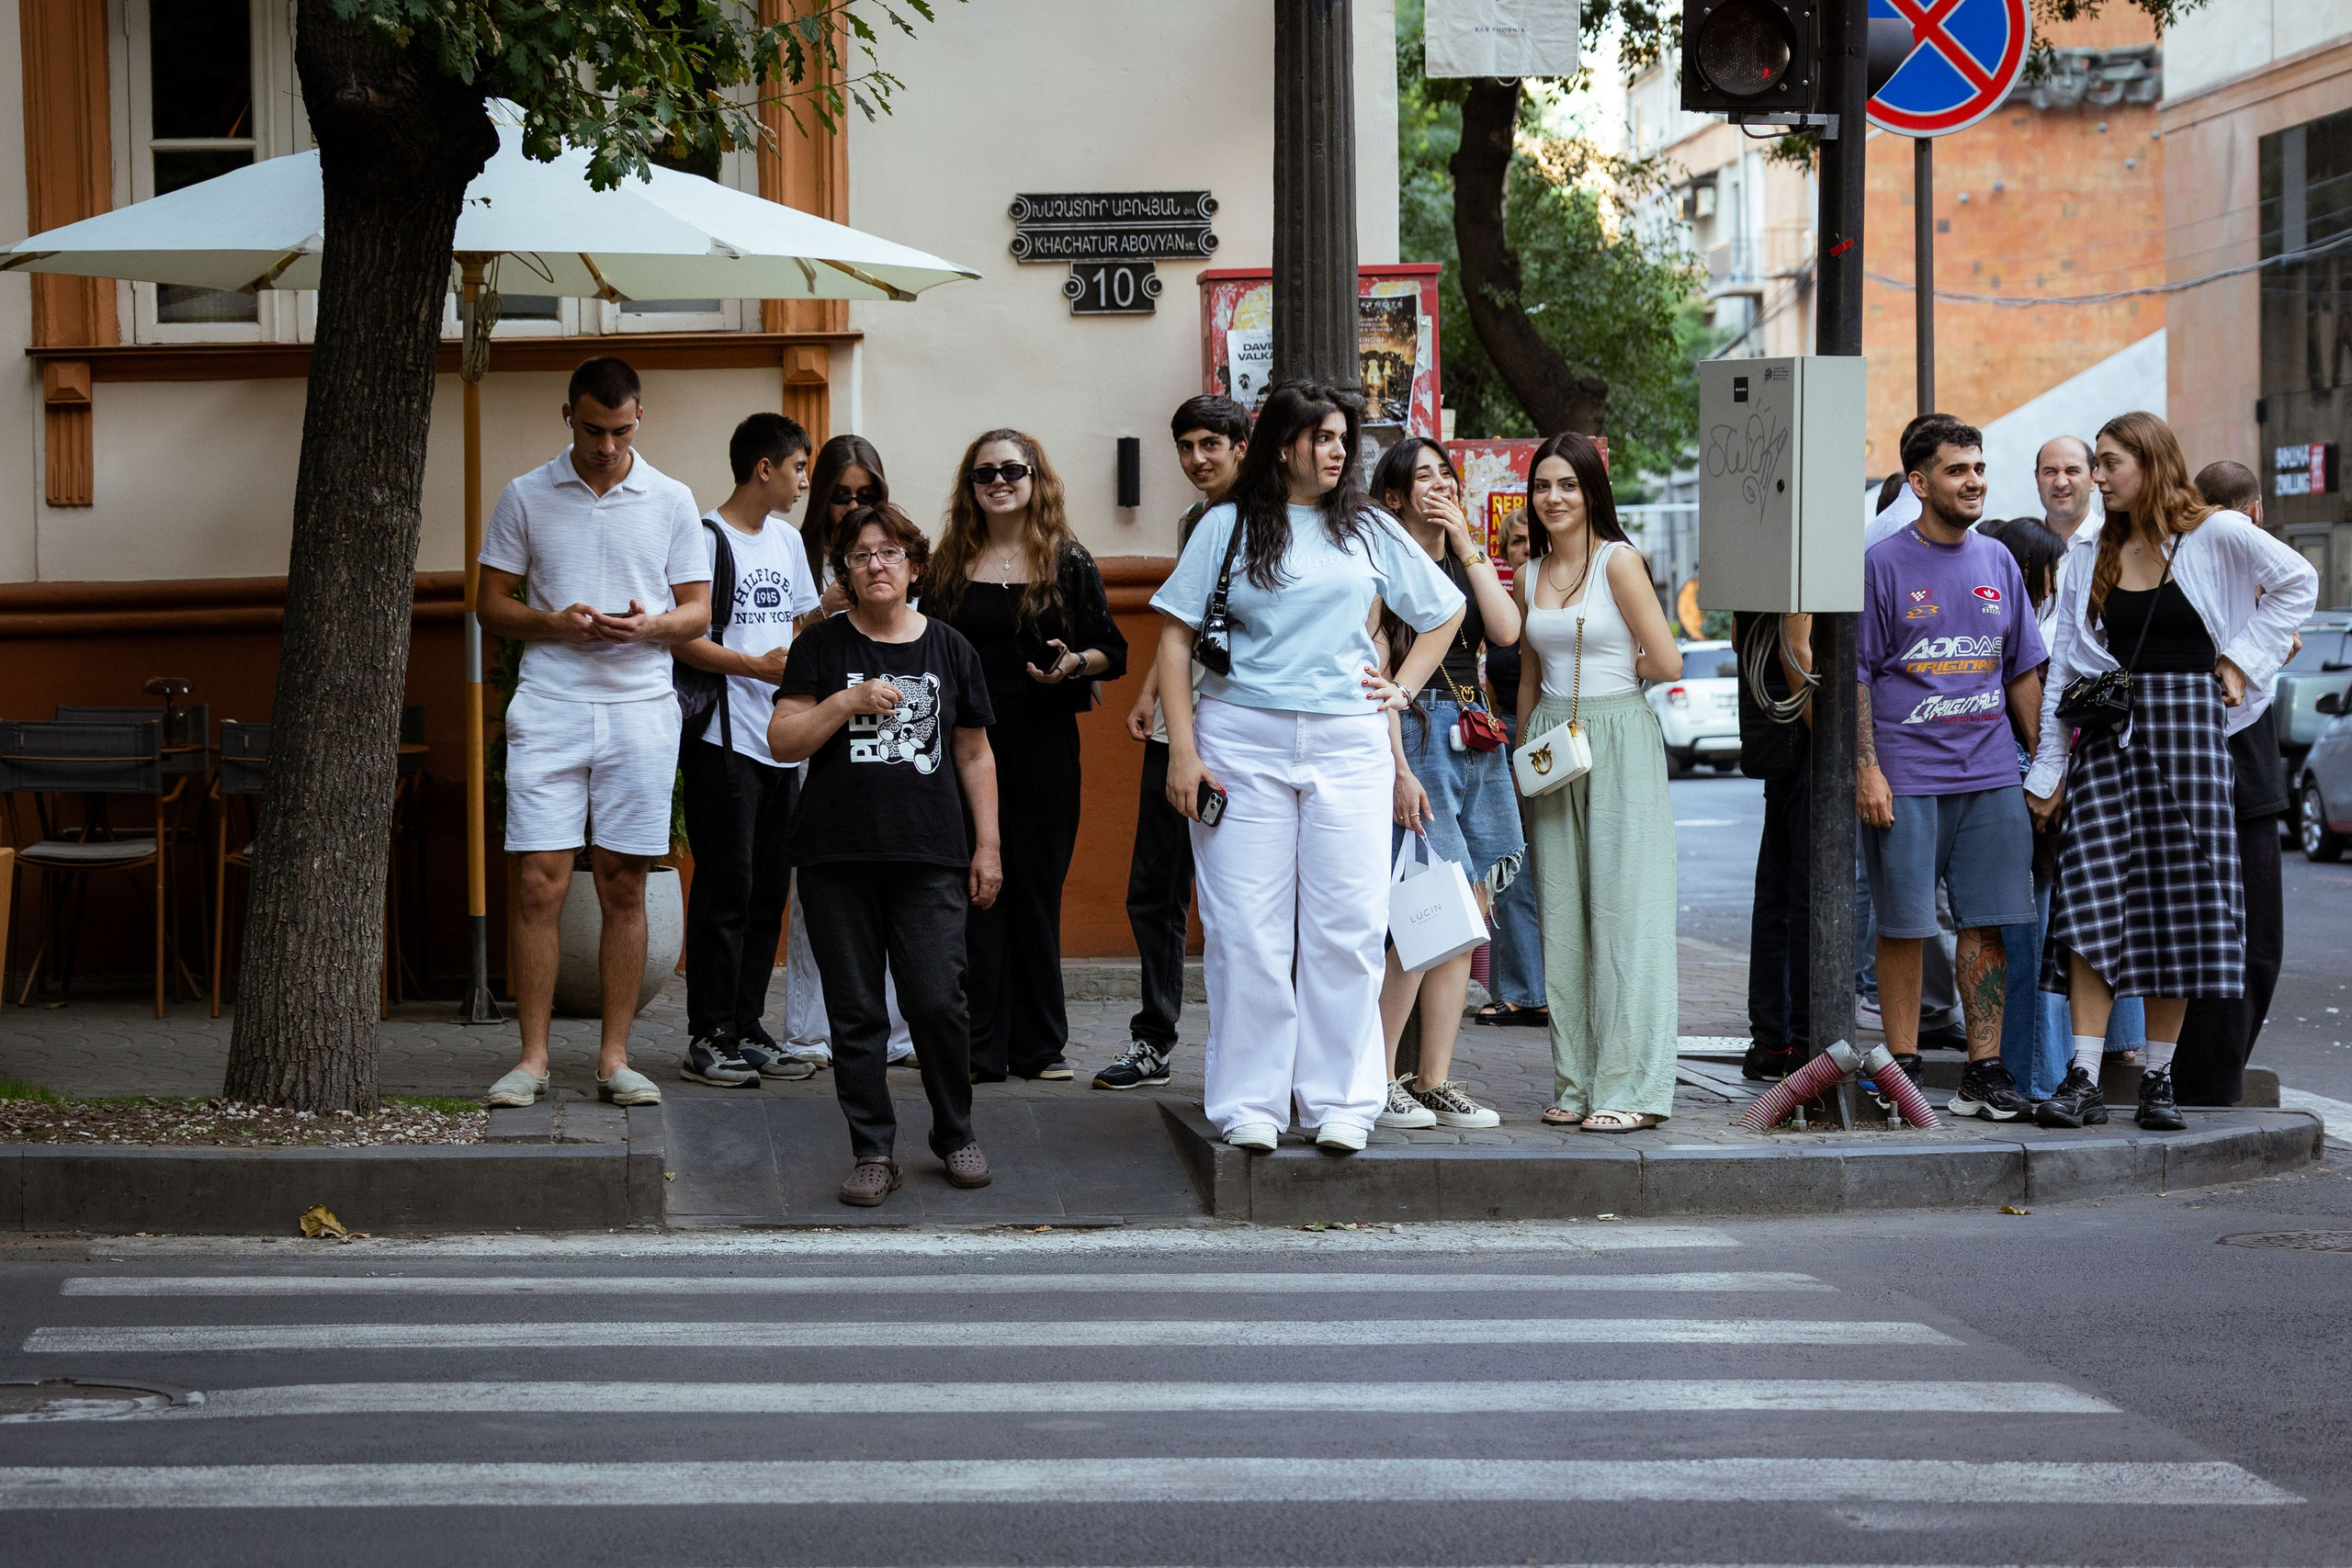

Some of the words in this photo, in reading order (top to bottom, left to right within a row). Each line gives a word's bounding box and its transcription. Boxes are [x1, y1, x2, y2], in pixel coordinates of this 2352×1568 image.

[1032, 198, 1109, 218] ԽԱՉԱՏՈՒՐ
[1112, 197, 1181, 217] ԱԲՈՎՅԱՆ
[1035, 235, 1118, 254] KHACHATUR
[1120, 233, 1184, 253] ABOVYAN
[1185, 241, 1197, 251] str.
[1092, 267, 1135, 307] 10
[755, 591, 779, 604] 1985
[734, 612, 766, 625] NEW
[769, 610, 794, 624] YOR
[1900, 635, 2003, 660] ADIDAS
